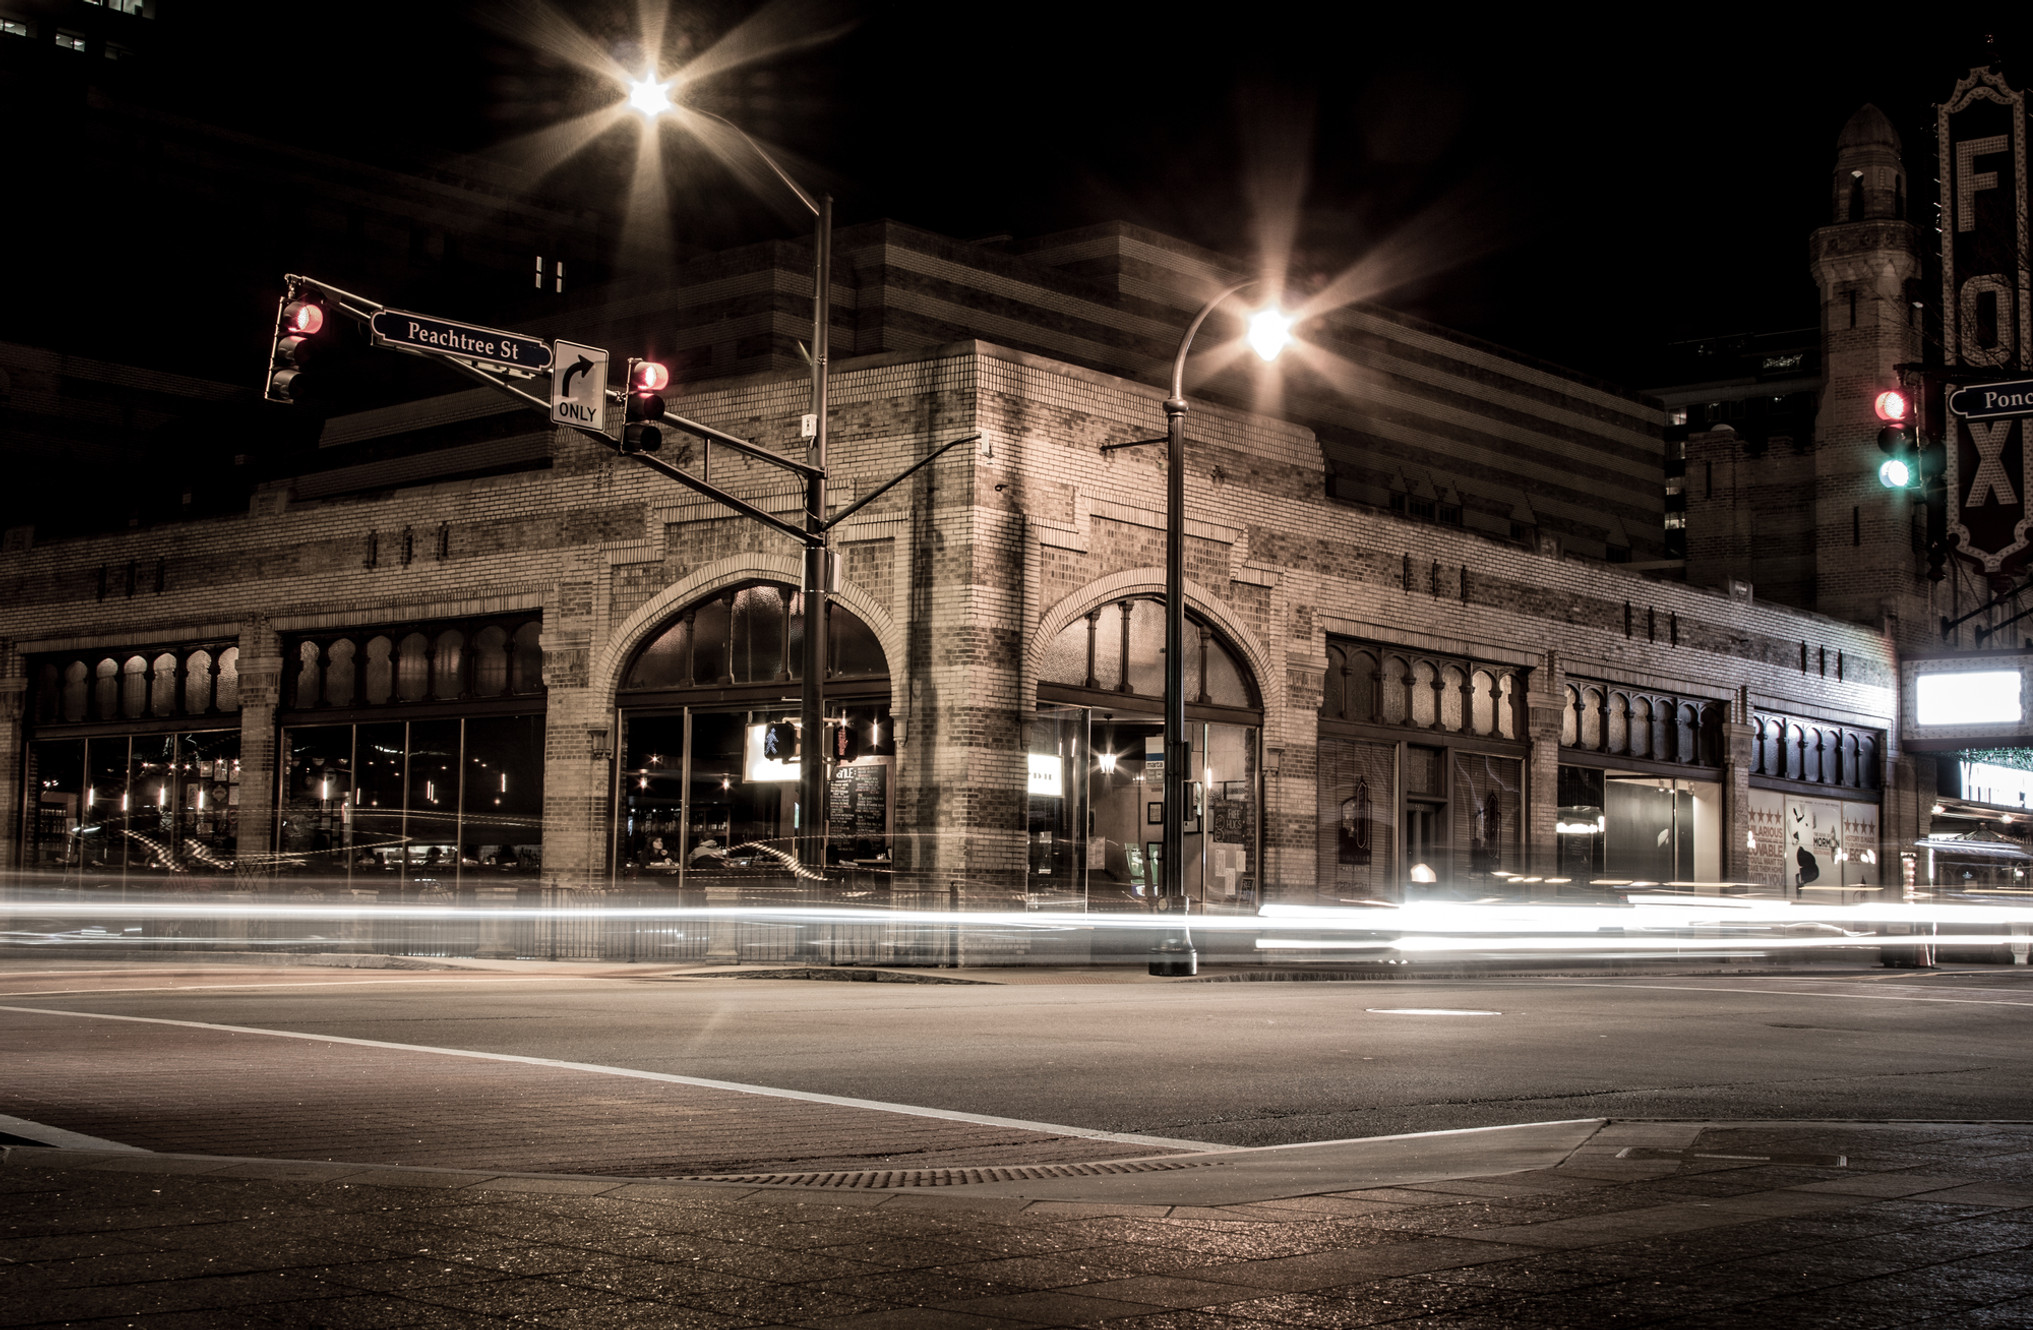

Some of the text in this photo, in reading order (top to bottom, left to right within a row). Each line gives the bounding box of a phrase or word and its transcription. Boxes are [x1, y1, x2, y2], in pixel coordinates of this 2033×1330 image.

[1956, 134, 2018, 507] FOX
[408, 321, 519, 360] Peachtree St
[559, 401, 597, 422] ONLY
[1984, 391, 2033, 409] Ponc
